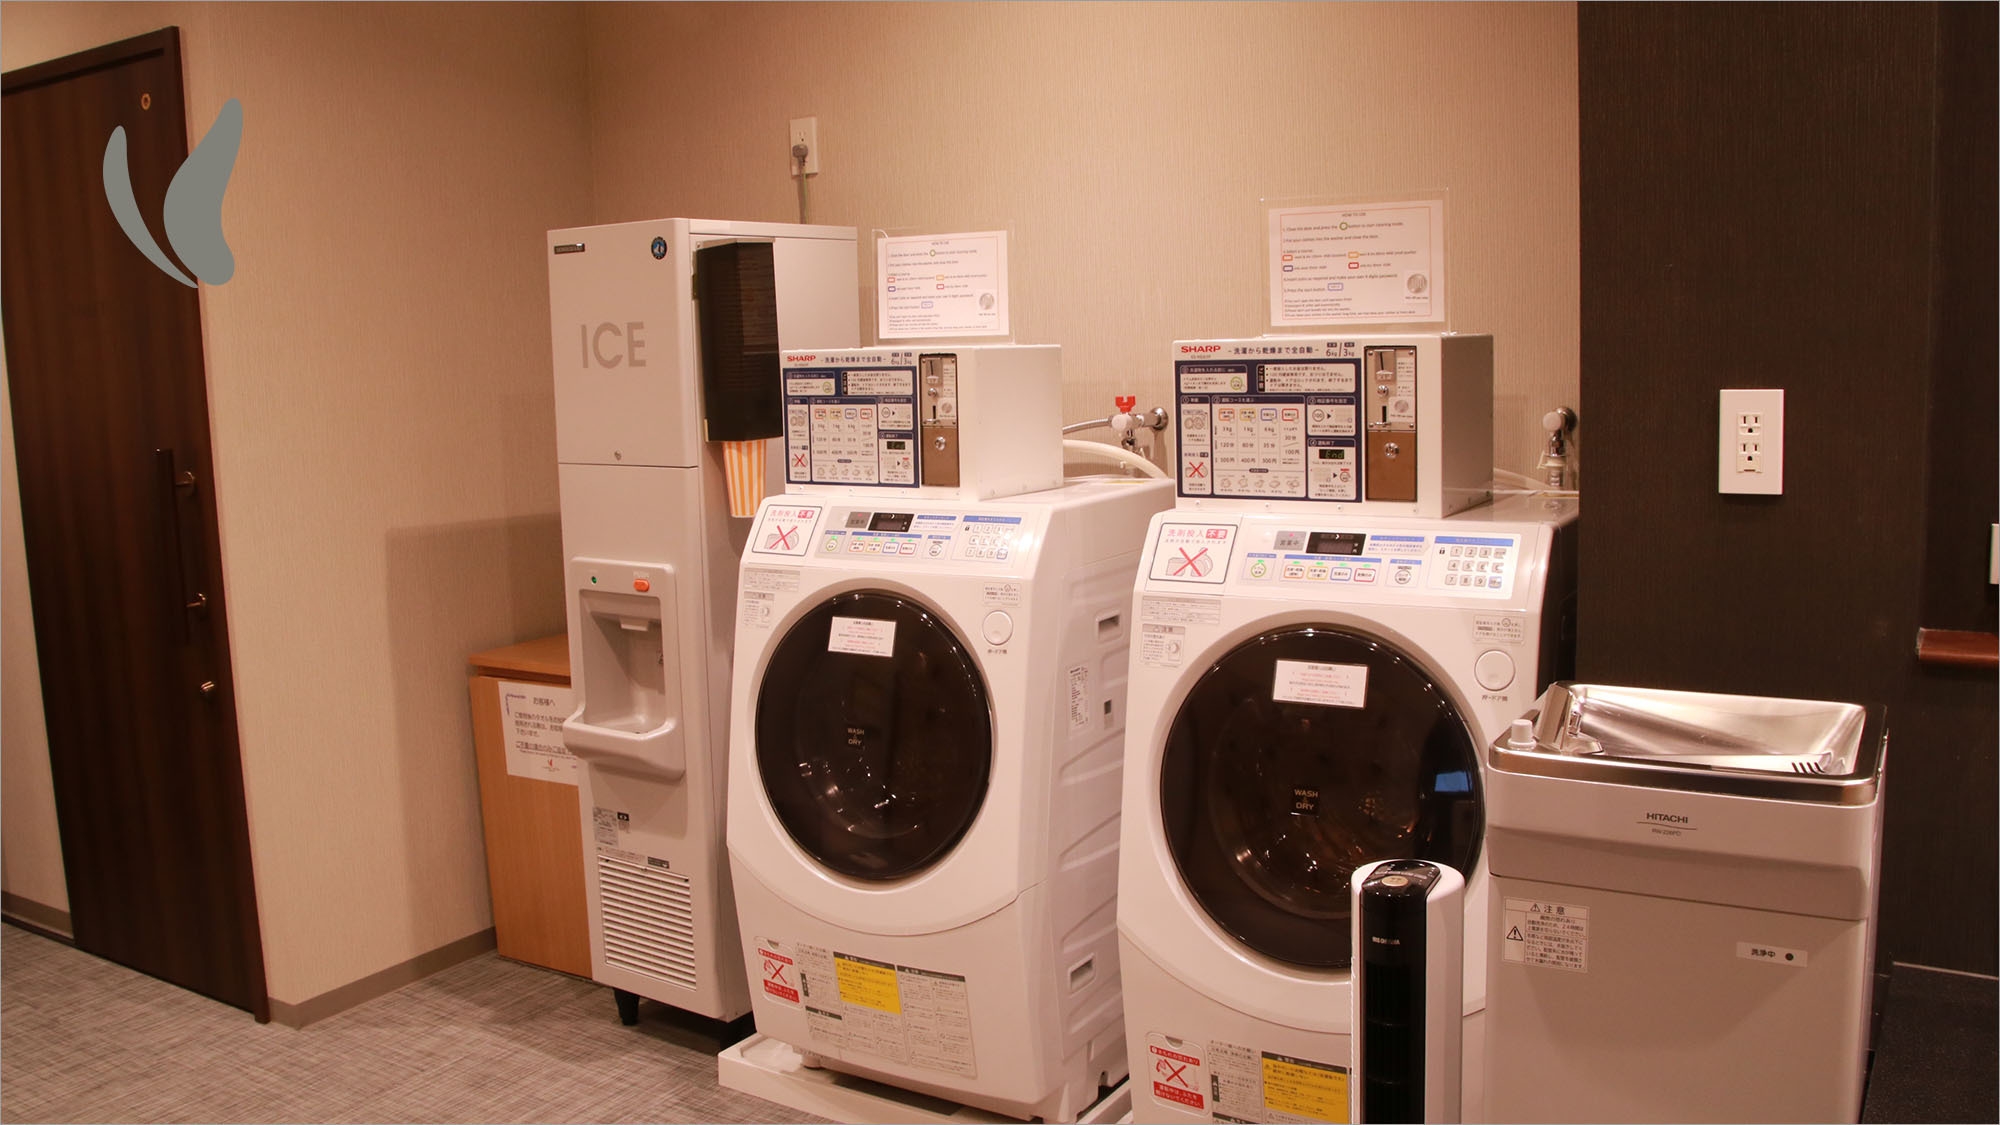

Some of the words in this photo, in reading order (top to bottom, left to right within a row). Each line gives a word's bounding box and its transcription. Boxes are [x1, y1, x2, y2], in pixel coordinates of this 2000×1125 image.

[581, 321, 647, 369] ICE
[1294, 789, 1318, 798] WASH
[1646, 812, 1688, 824] HITACHI
[1544, 904, 1565, 915] 注意
[1751, 948, 1776, 958] 洗浄中
